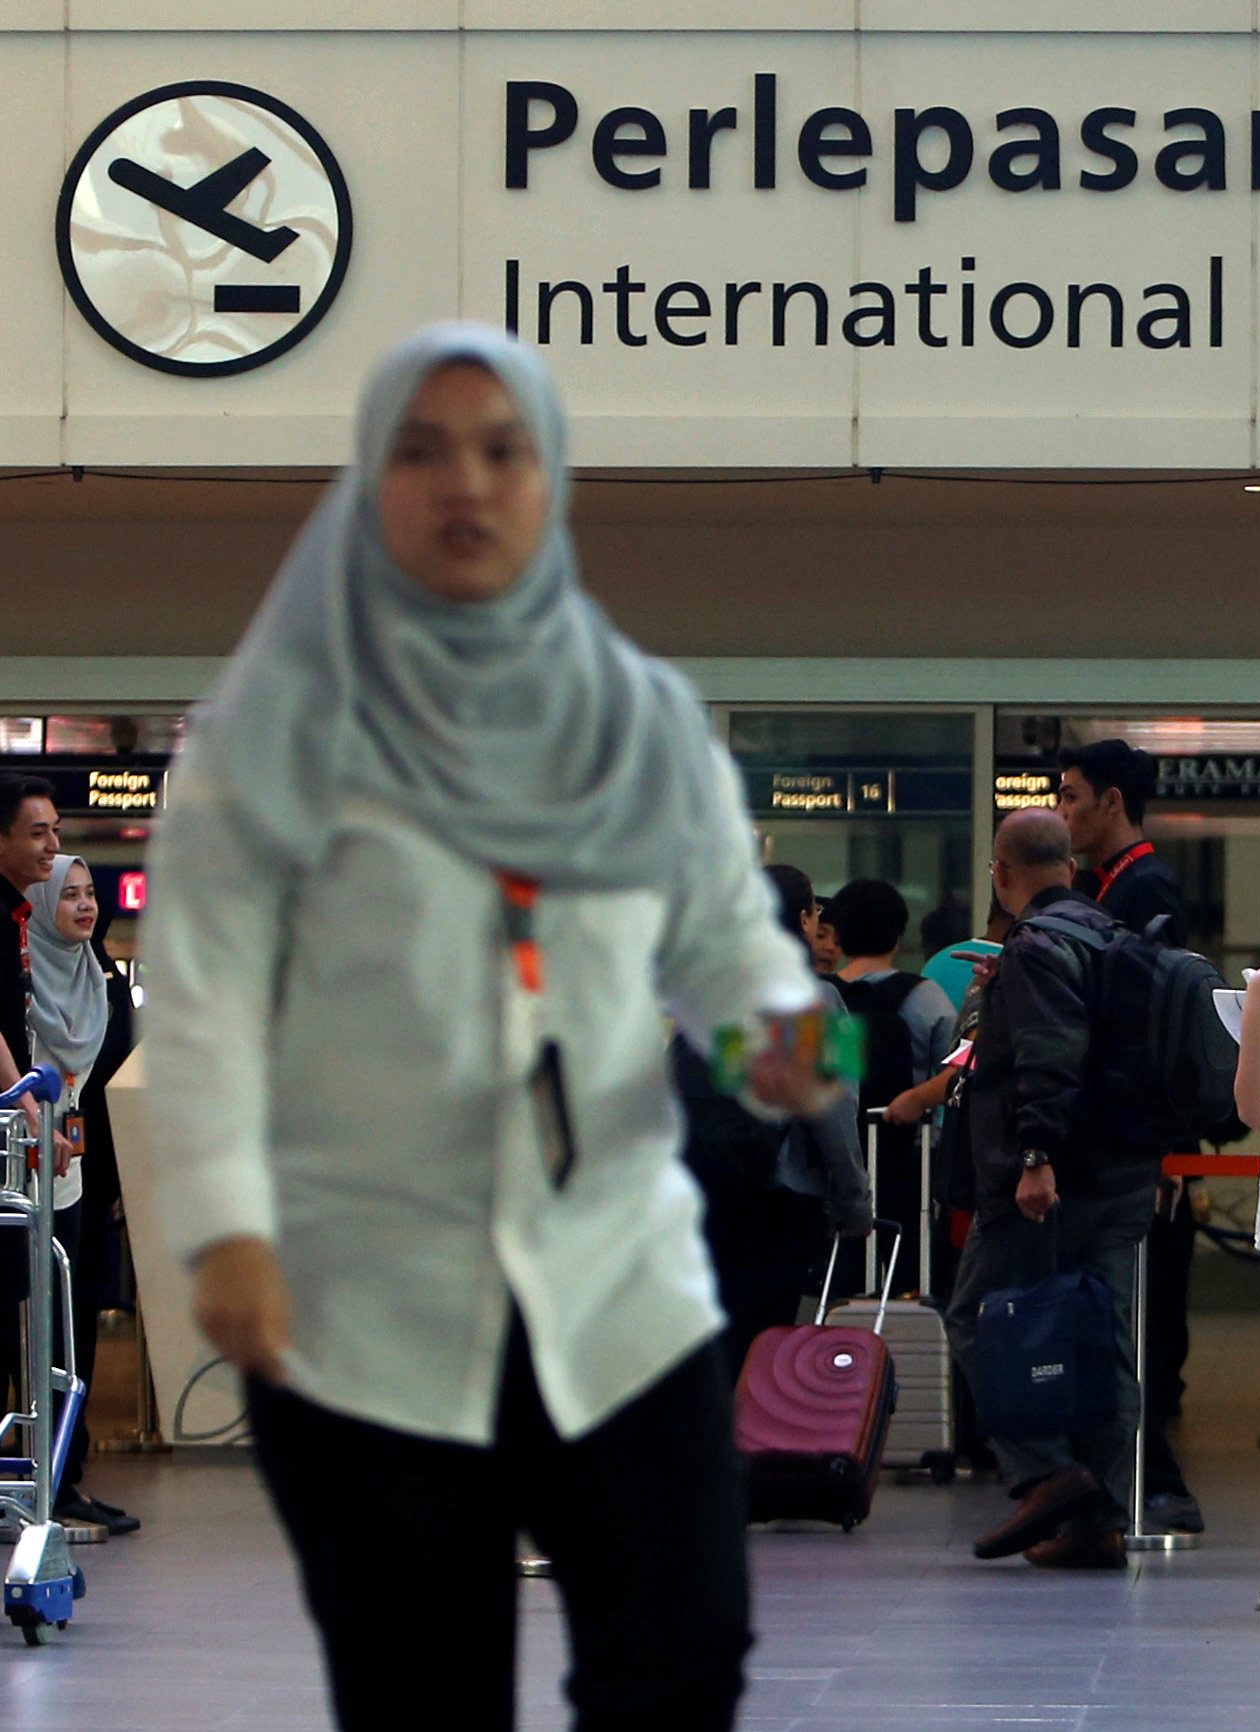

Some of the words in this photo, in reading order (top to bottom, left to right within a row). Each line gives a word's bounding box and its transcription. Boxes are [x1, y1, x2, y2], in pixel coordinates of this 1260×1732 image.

[505, 255, 1223, 349] International
[89, 771, 150, 792] Foreign
[773, 774, 833, 792] Foreign
[861, 783, 881, 801] 16
[995, 772, 1050, 793] oreign
[89, 790, 157, 811] Passport
[772, 791, 842, 812] Passport
[994, 793, 1058, 810] assport
